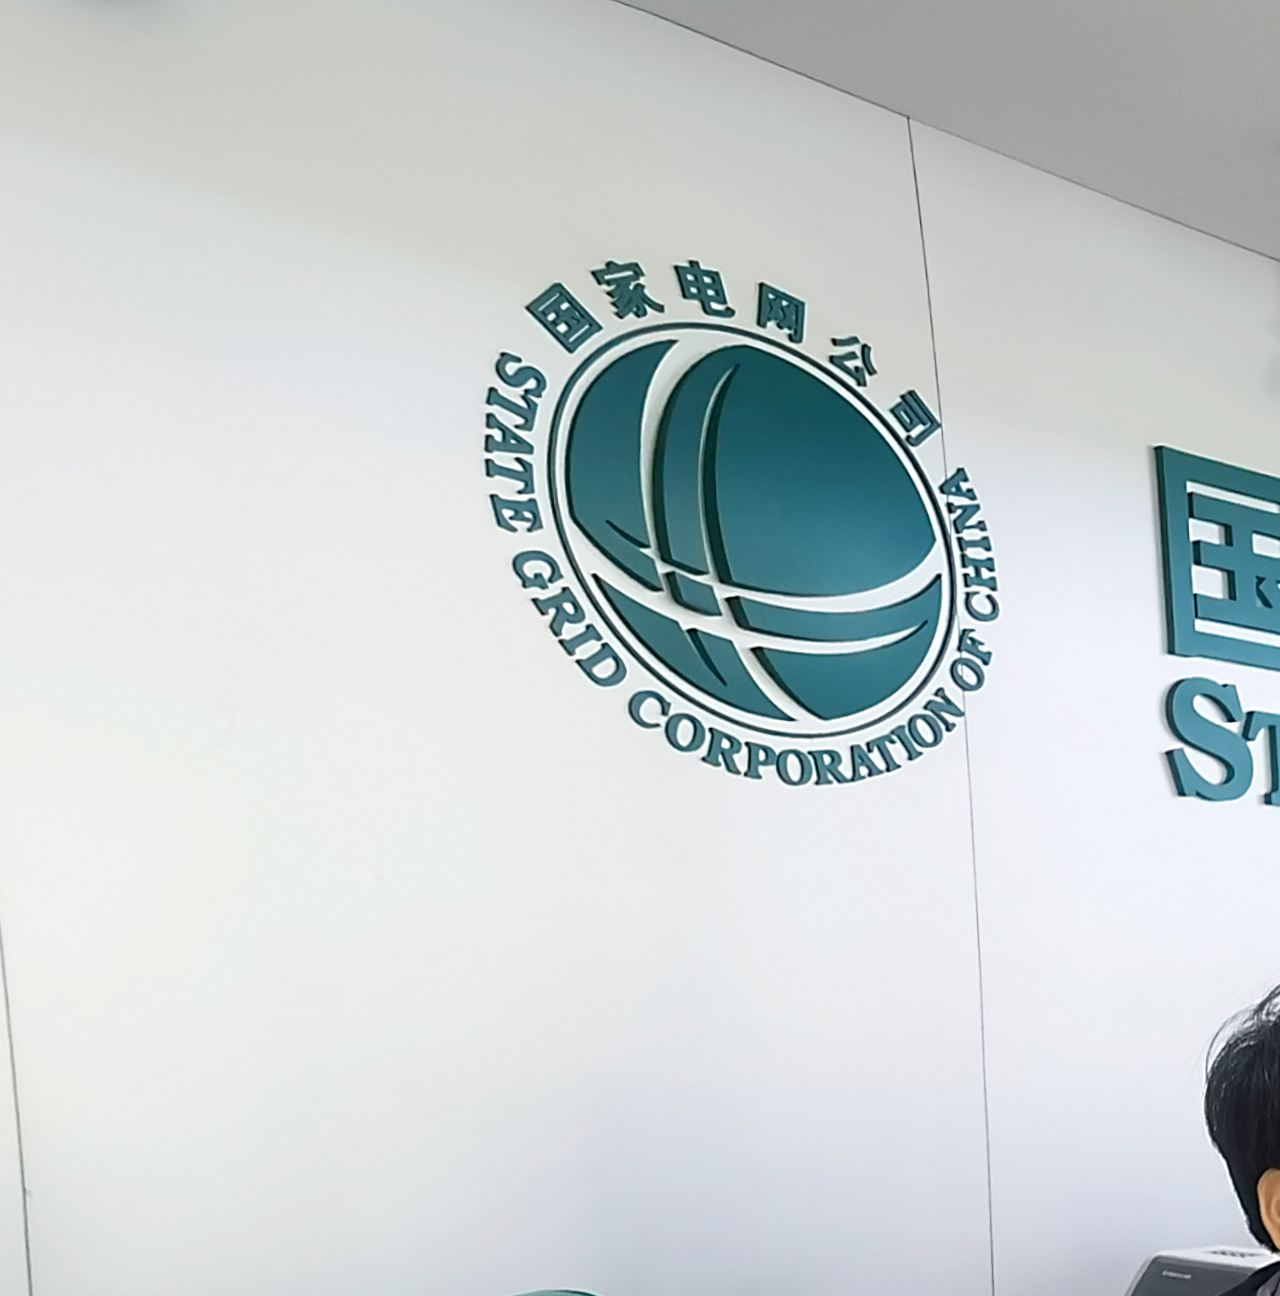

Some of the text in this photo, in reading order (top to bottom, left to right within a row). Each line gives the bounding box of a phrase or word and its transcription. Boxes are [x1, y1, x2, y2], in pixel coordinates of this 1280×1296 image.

[526, 260, 942, 447] 国家电网公司
[484, 352, 1001, 786] STATE GRID CORPORATION OF CHINA
